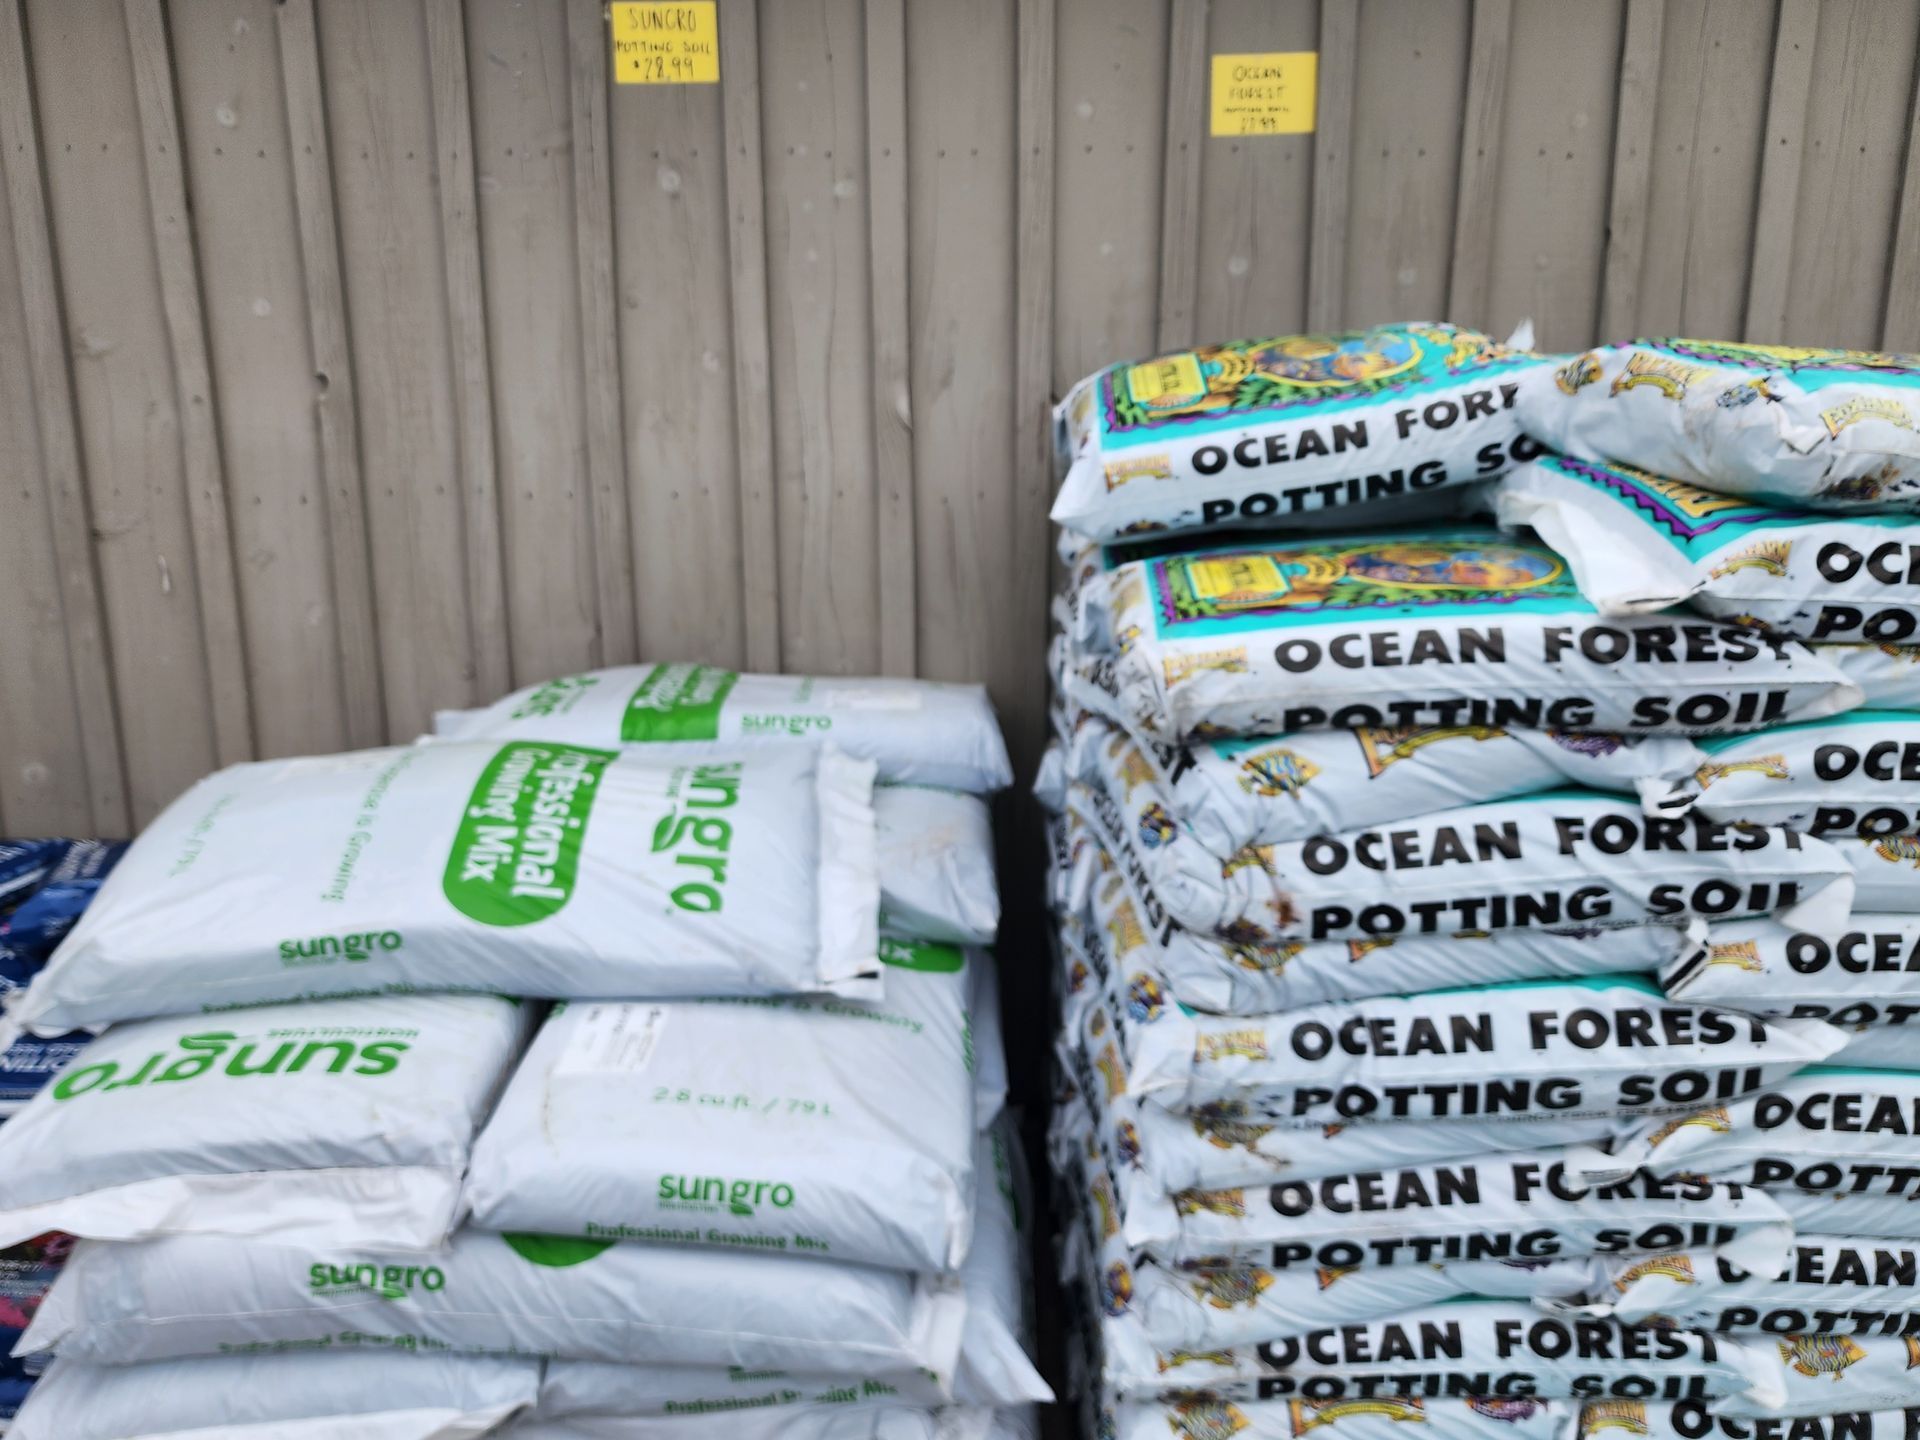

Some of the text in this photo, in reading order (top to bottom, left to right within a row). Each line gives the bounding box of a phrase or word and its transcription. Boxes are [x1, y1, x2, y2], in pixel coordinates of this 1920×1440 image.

[1191, 420, 1368, 475] OCEAN
[1202, 460, 1447, 524] POTTING
[1274, 627, 1506, 673] OCEAN
[1543, 626, 1791, 664] FOREST
[739, 713, 832, 736] sungro
[1283, 689, 1790, 731] POTTING SOIL
[460, 825, 518, 882] Mix
[1302, 815, 1802, 875] OCEAN FOREST
[1312, 886, 1612, 939] POTTING
[278, 930, 401, 962] sungro
[1291, 1012, 1494, 1061] OCEAN
[1528, 1008, 1767, 1050] FOREST
[53, 1031, 412, 1102] sungro
[1292, 1077, 1582, 1118] POTTING
[658, 1173, 795, 1216] sungro
[1270, 1165, 1480, 1217] OCEAN
[587, 1221, 830, 1251] Professional Growing Mix
[1273, 1229, 1562, 1268] POTTING
[309, 1262, 446, 1298] sungro
[1717, 1247, 1917, 1286] EAN
[1257, 1319, 1718, 1366] OCEAN FOREST
[664, 1388, 780, 1415] Professional
[1258, 1372, 1717, 1400] POTTING SOIL
[1670, 1400, 1872, 1440] OCEAN
